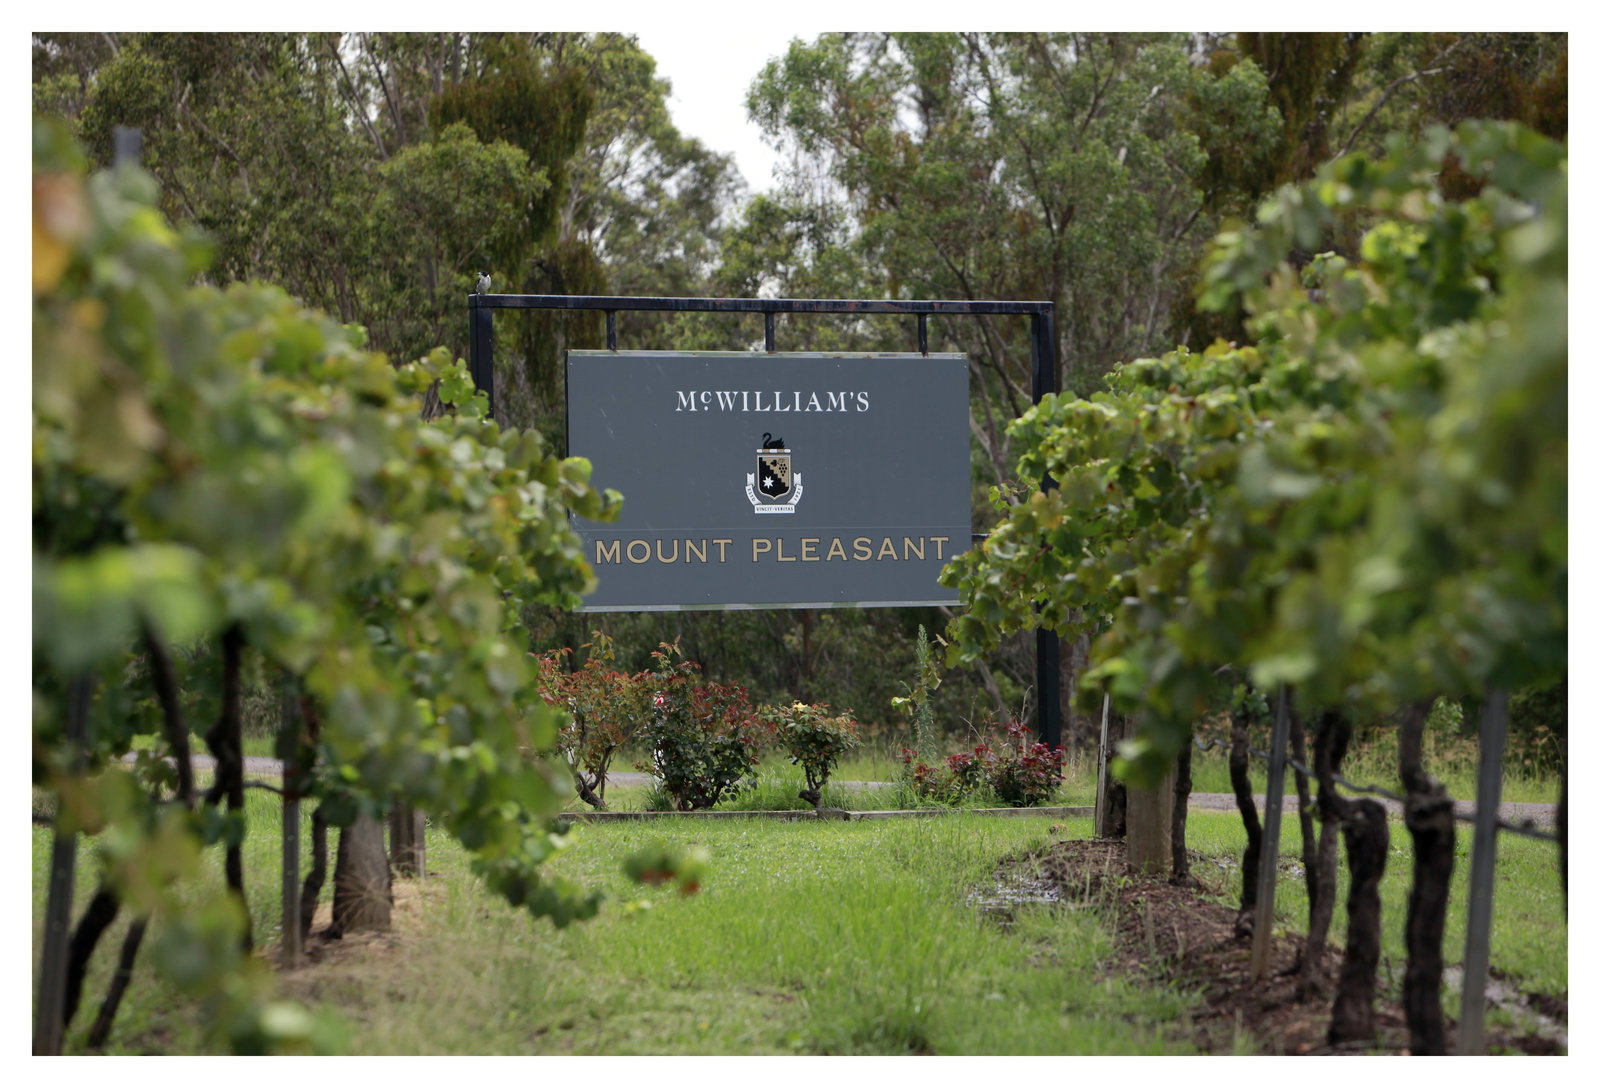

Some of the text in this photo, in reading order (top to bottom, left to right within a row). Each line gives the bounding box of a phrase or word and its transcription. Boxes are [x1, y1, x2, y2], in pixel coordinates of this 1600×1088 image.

[675, 390, 870, 413] McWILLIAM'S
[595, 536, 950, 565] MOUNT PLEASANT
